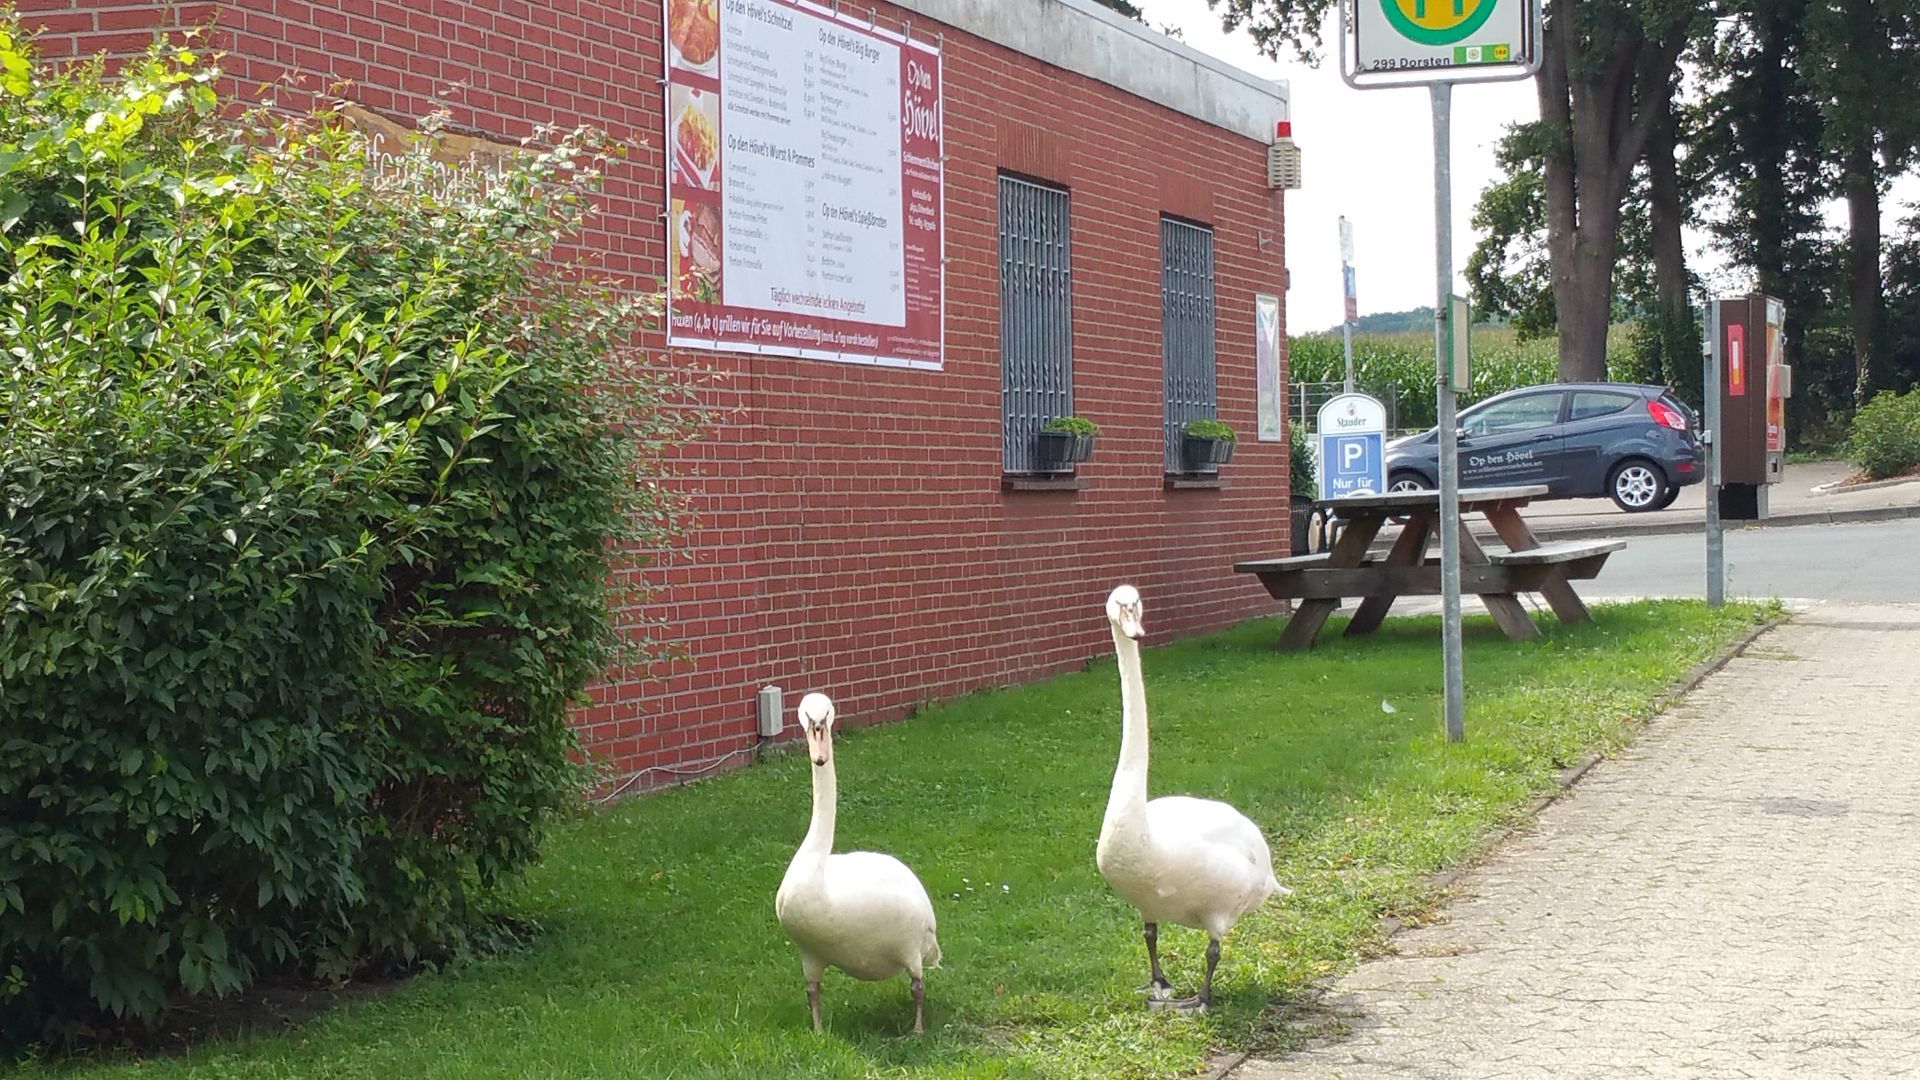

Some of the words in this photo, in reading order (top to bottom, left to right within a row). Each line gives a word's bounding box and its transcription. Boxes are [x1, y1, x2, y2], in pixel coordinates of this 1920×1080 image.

[767, 9, 793, 31] Schnitzel
[819, 28, 826, 46] Op
[827, 31, 836, 46] den
[864, 43, 880, 64] Burger
[907, 60, 919, 91] Op
[919, 64, 932, 90] den
[1373, 59, 1396, 70] 299
[1400, 57, 1450, 68] Dorsten
[902, 89, 939, 144] Hövel
[728, 134, 736, 153] Op
[737, 136, 748, 152] den
[769, 144, 787, 161] Wurst
[787, 148, 792, 162] &
[792, 149, 815, 168] Pommes
[822, 202, 829, 220] Op
[719, 314, 740, 337] grillen
[741, 316, 750, 333] wir
[750, 317, 761, 339] für
[761, 318, 771, 336] Sie
[772, 320, 784, 341] auf
[784, 321, 821, 346] Vorbestellung
[1337, 416, 1367, 428] Stauder
[1344, 443, 1362, 469] P
[1469, 456, 1485, 467] Op
[1487, 454, 1504, 465] den
[1505, 449, 1534, 463] Hövel
[1333, 478, 1353, 489] Nur
[1357, 477, 1373, 488] für
